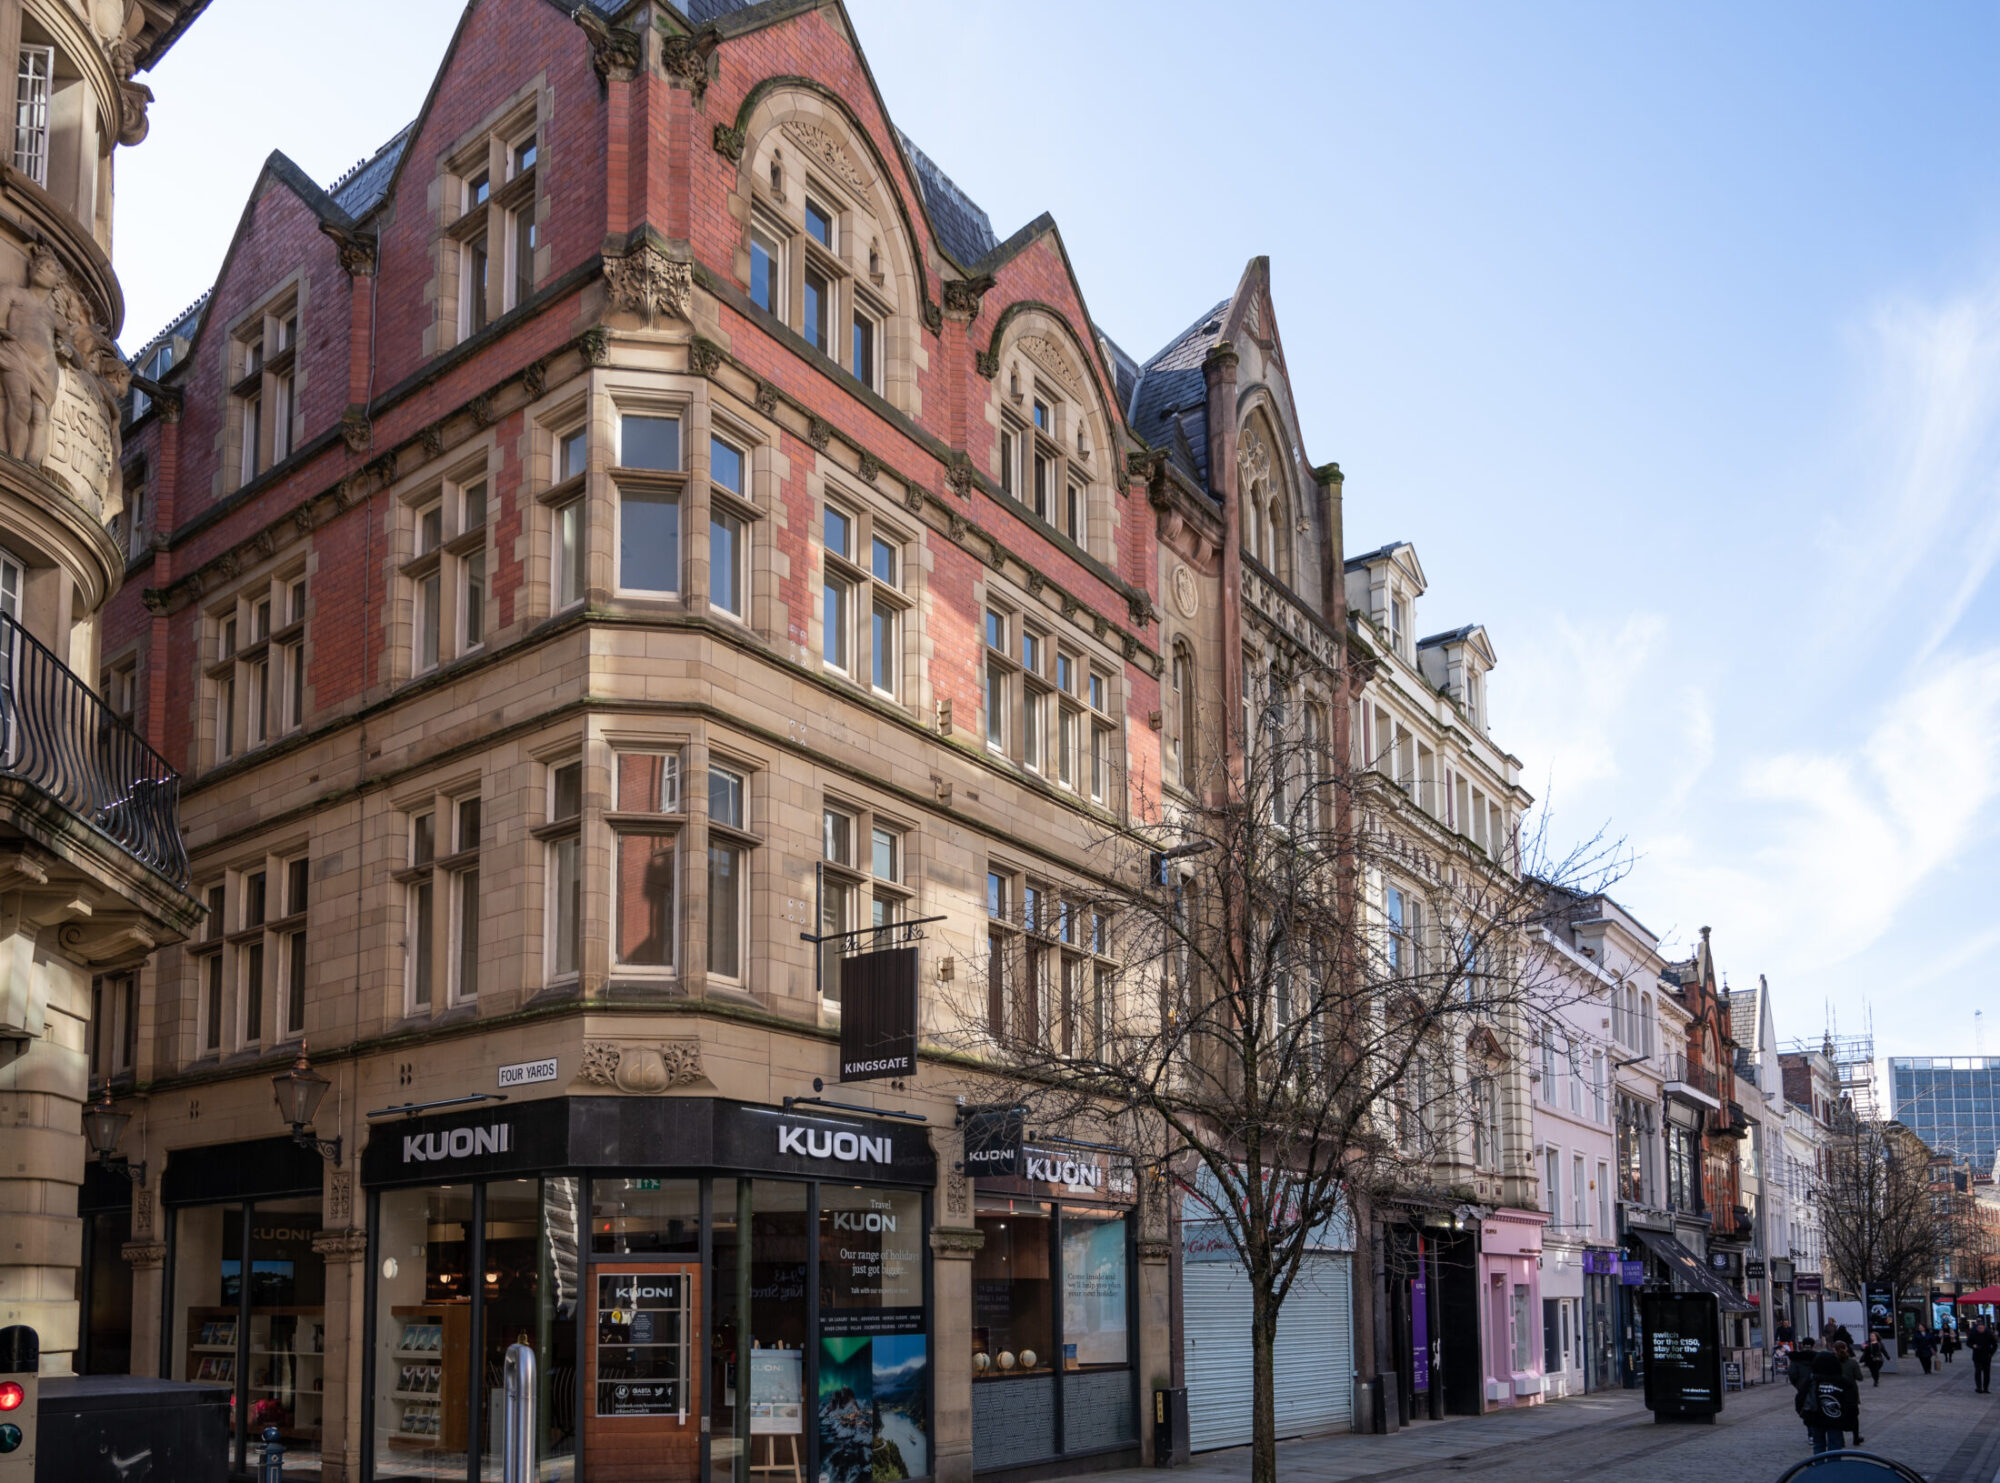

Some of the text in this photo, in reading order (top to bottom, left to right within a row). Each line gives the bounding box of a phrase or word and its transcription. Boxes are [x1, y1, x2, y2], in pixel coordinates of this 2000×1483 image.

[501, 1063, 555, 1083] FOUR YARDS
[845, 1057, 909, 1074] KINGSGATE
[403, 1123, 509, 1164] KUONI
[778, 1125, 892, 1164] KUONI
[969, 1150, 1015, 1162] KUONI
[1026, 1157, 1102, 1187] KUONI
[870, 1199, 891, 1210] Travel
[840, 1248, 857, 1260] Our
[858, 1251, 880, 1263] range
[881, 1249, 890, 1260] of
[852, 1263, 867, 1277] just
[868, 1265, 881, 1278] got
[615, 1287, 673, 1299] KUONI
[1653, 1345, 1671, 1353] stay
[1684, 1345, 1697, 1353] the
[1680, 1338, 1701, 1347] £150,
